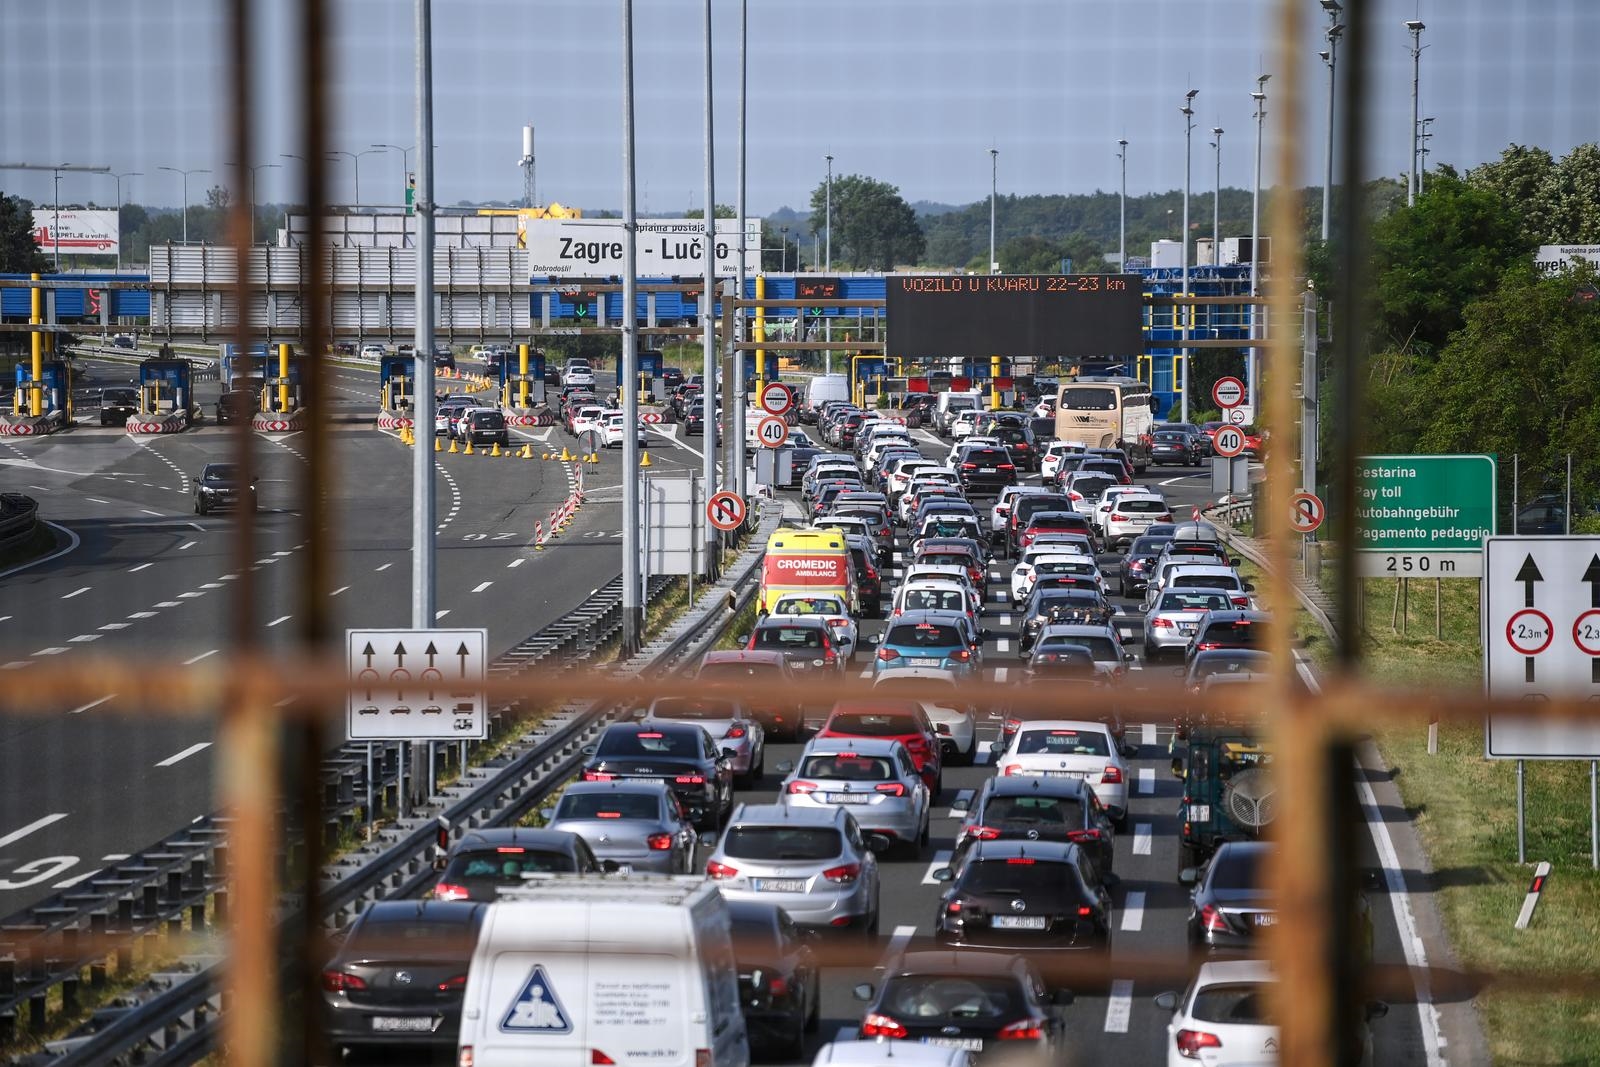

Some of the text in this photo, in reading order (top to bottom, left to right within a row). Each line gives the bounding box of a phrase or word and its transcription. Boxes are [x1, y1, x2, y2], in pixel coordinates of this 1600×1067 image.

[635, 222, 668, 233] aplatna
[672, 222, 705, 233] postaja
[559, 237, 624, 264] Zagre
[661, 237, 729, 260] Lučo
[533, 264, 572, 272] Dobrodošli!
[903, 277, 1126, 292] VOZILO U KVARU 22-23 km
[764, 424, 782, 439] 40
[1220, 434, 1238, 449] 40
[1381, 486, 1402, 498] toll
[1354, 506, 1459, 521] Autobahngebühr
[1431, 527, 1490, 541] pedaggio
[777, 560, 837, 569] CROMEDIC
[1386, 556, 1456, 572] 250 m
